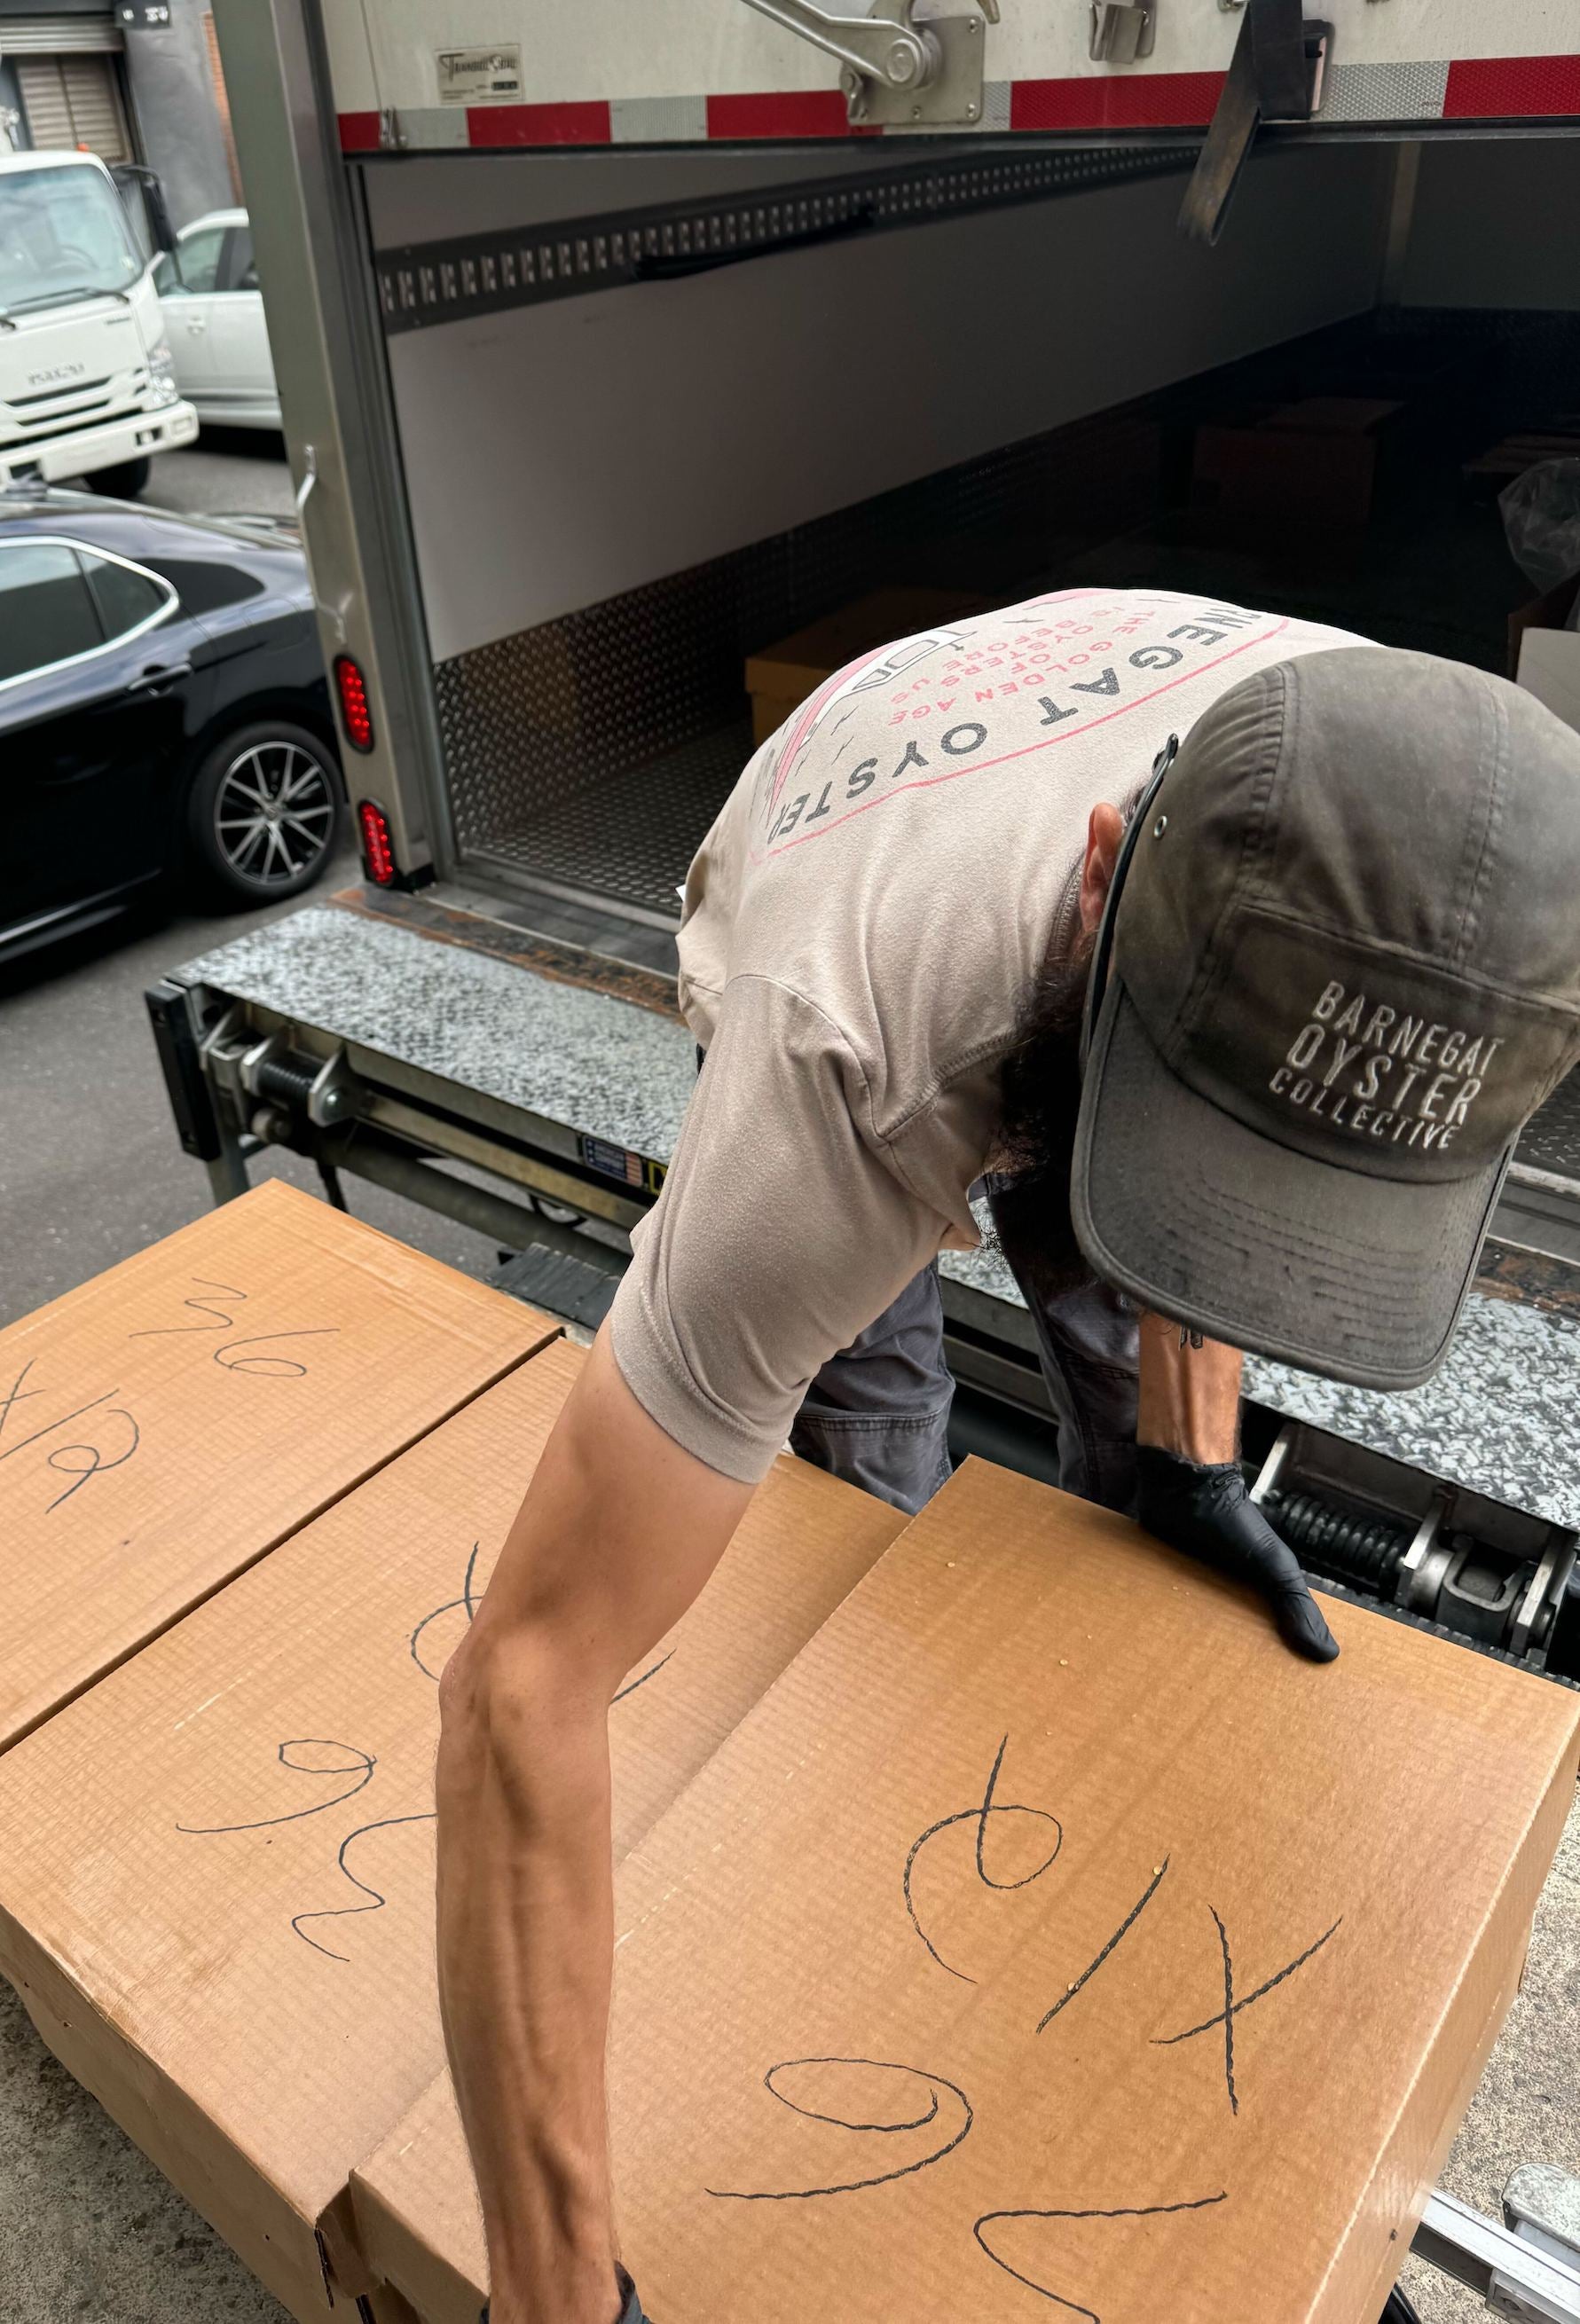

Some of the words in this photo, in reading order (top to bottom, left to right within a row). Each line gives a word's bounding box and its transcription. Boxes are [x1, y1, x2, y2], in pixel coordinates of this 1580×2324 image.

[941, 620, 1077, 671] BEFORE
[1112, 611, 1155, 633] THE
[940, 624, 1094, 687] OYSTERS
[975, 640, 1113, 703] GOLDEN
[1010, 653, 1050, 674] OF
[888, 698, 939, 726] AGE
[890, 678, 931, 704] US
[767, 722, 988, 844] OYSTER
[1312, 979, 1505, 1078] BARNEGAT
[1286, 1023, 1482, 1127] OYSTER
[1268, 1066, 1462, 1150] COLLECTIVE
